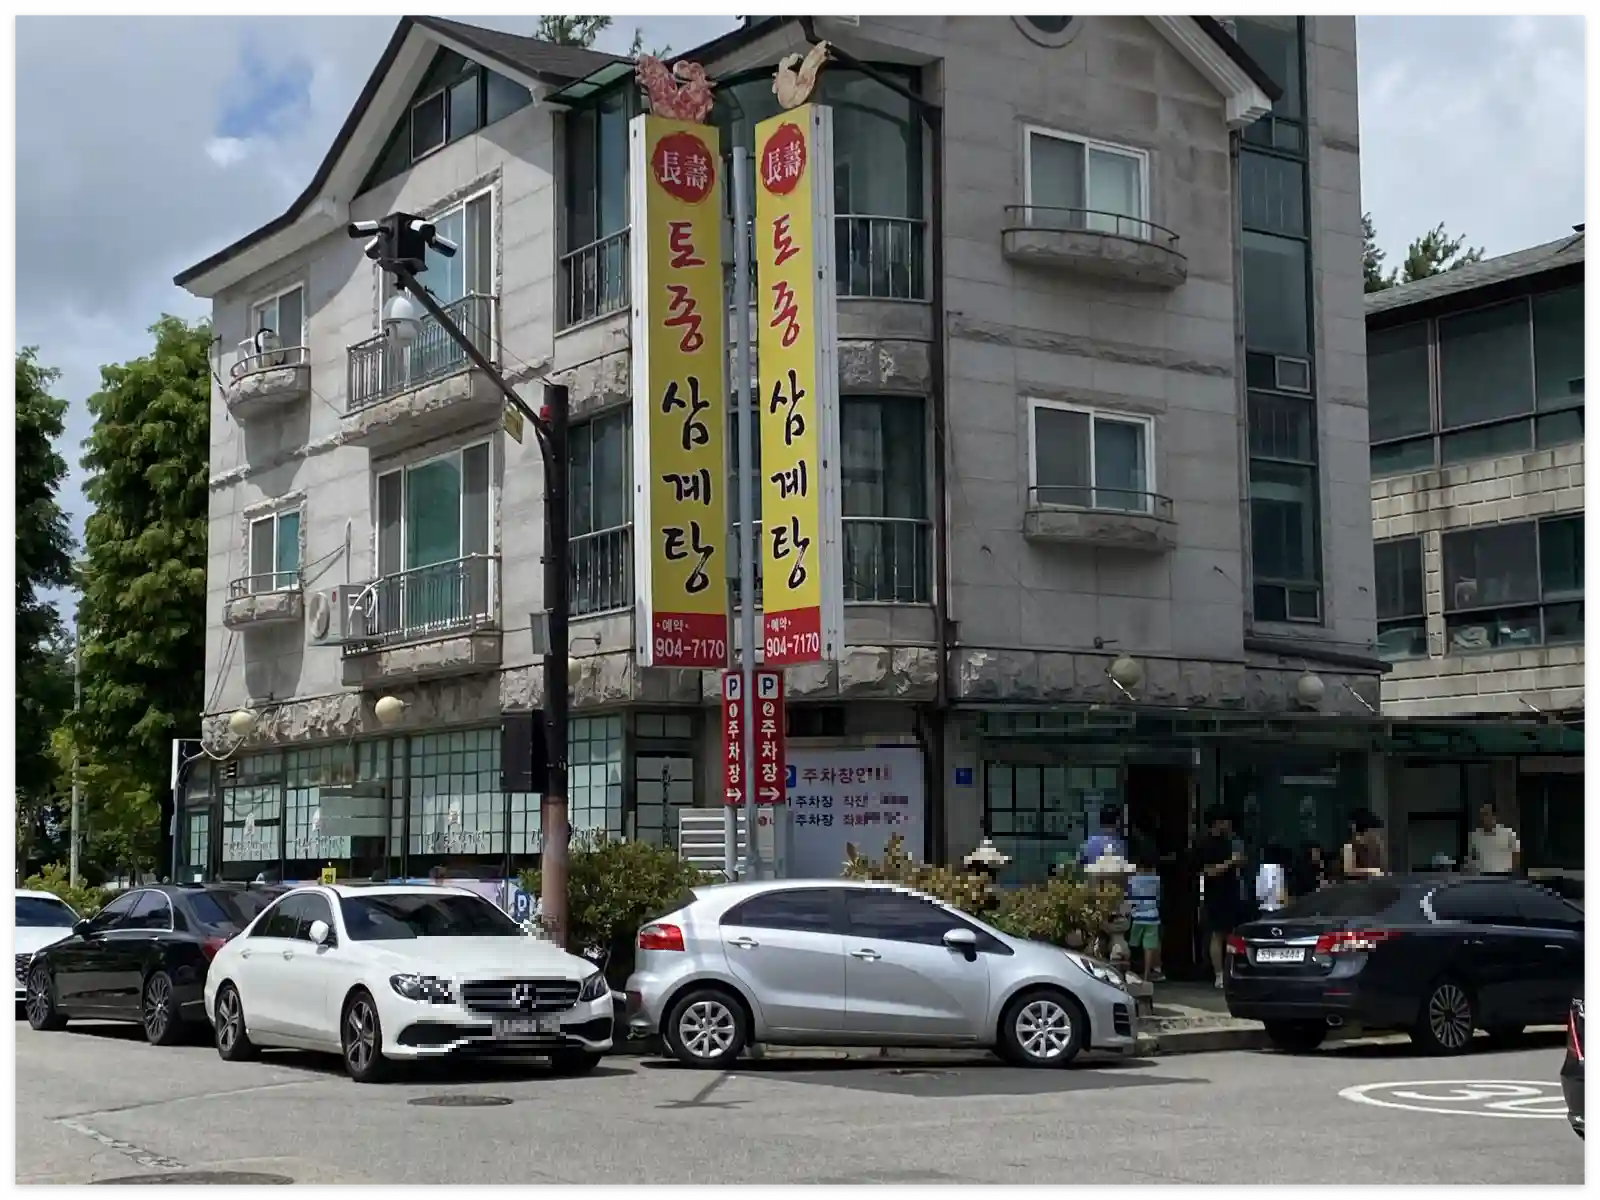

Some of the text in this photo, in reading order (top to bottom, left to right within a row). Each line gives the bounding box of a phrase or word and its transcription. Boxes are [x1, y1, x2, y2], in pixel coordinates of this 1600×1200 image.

[660, 149, 709, 191] 長壽
[766, 140, 802, 186] 長壽
[655, 638, 725, 659] 904-7170
[766, 632, 819, 658] 904-7170
[795, 795, 833, 808] 주차장
[795, 813, 834, 827] 주차장
